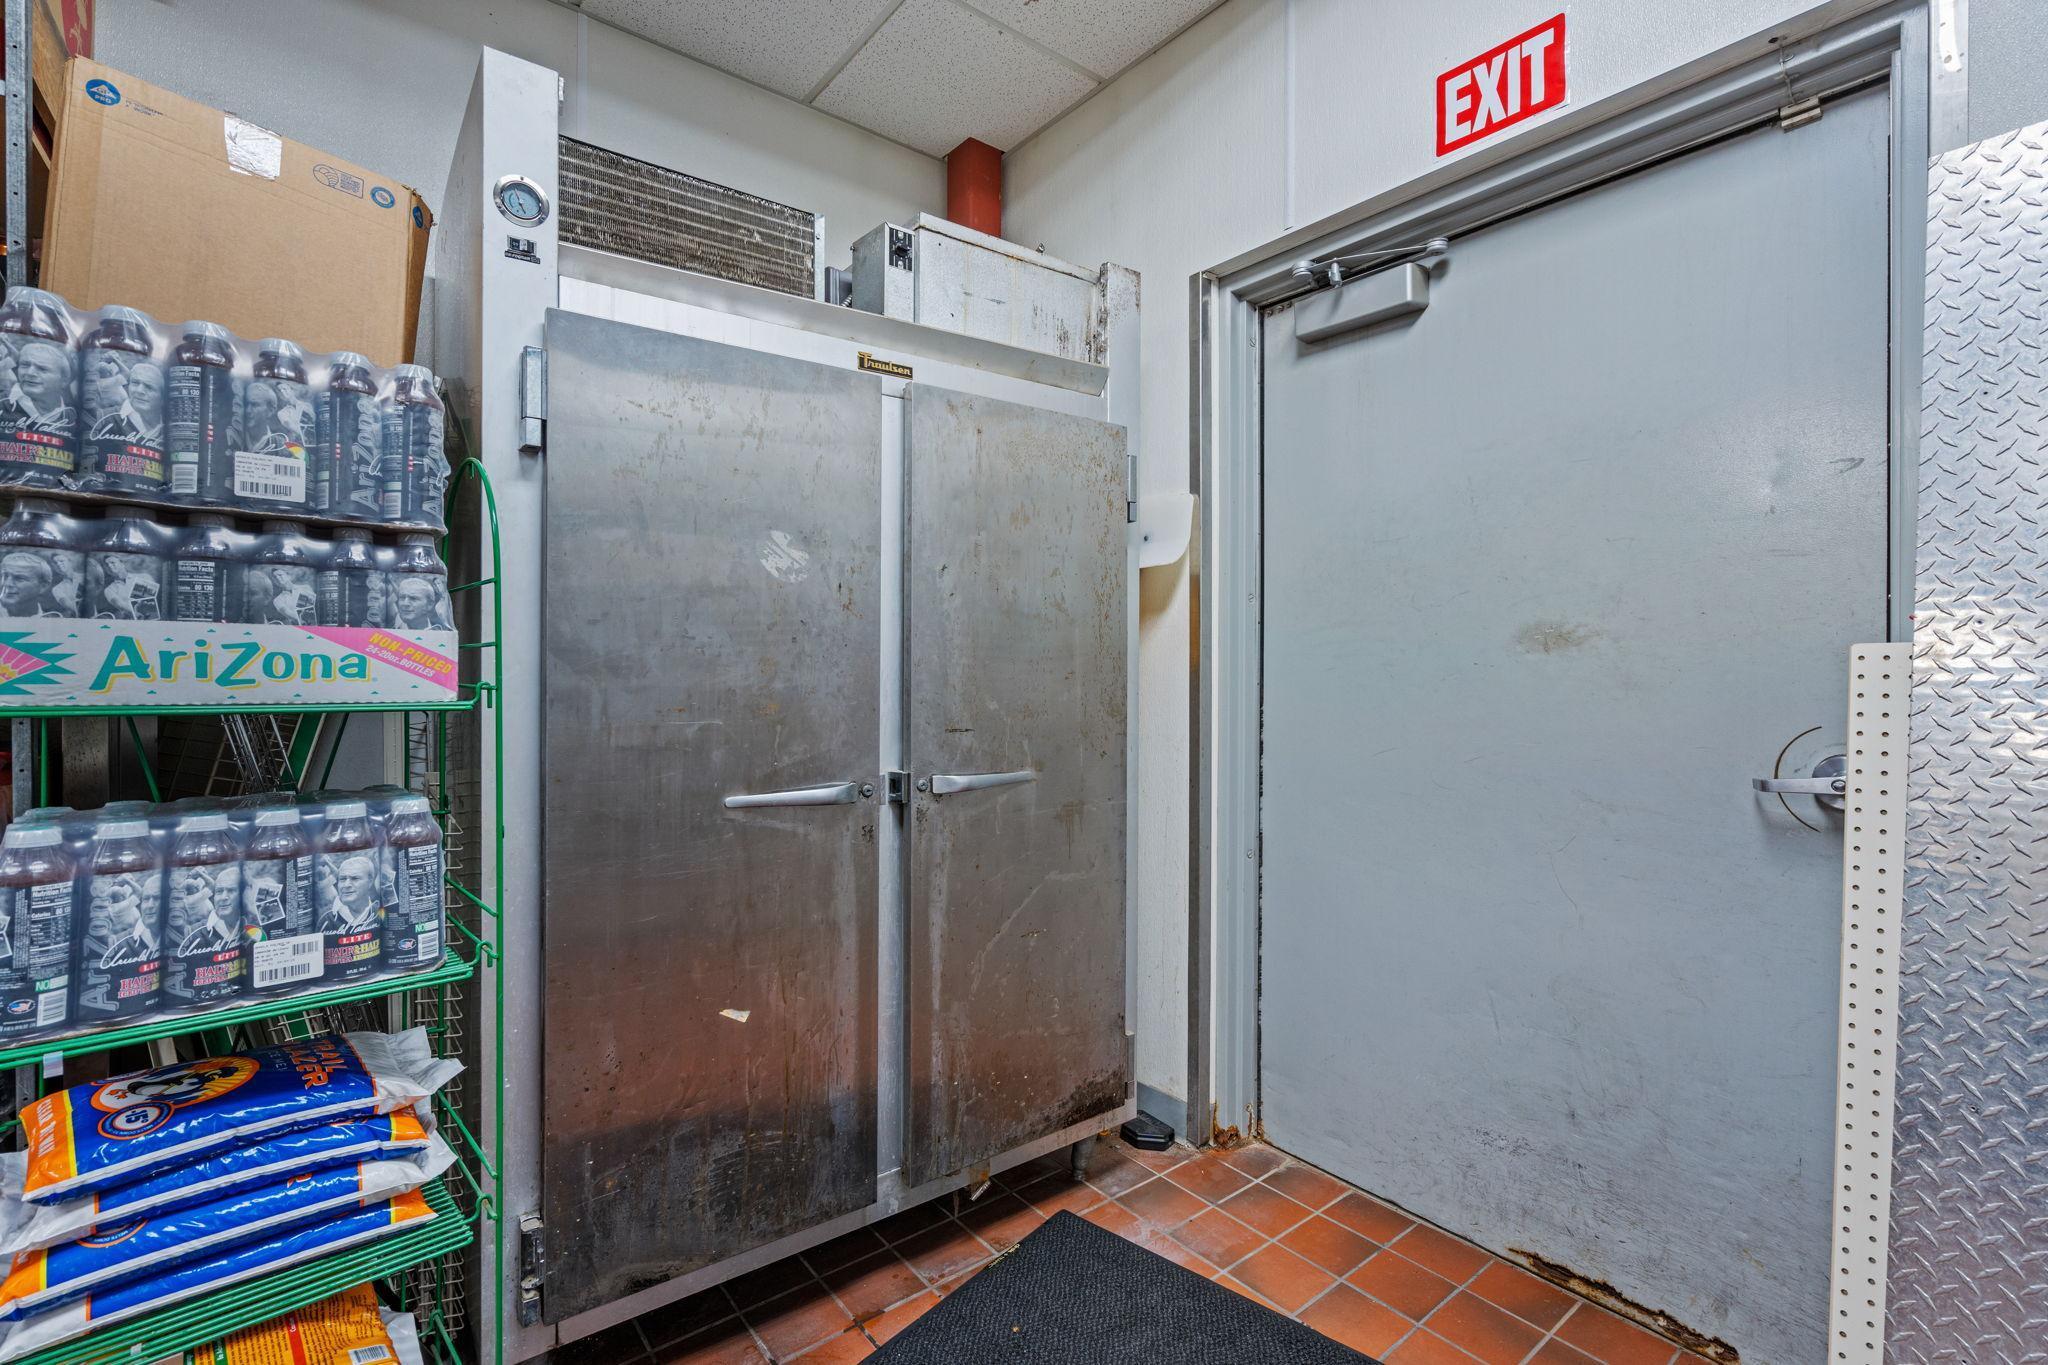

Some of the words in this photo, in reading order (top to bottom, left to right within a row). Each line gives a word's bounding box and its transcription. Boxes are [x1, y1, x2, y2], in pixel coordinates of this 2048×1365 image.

[1445, 27, 1555, 145] EXIT
[857, 351, 912, 376] Traulsen
[22, 432, 63, 446] LITE
[89, 635, 370, 693] AriZona
[369, 632, 452, 674] NON-PRICED
[343, 933, 371, 944] LITE
[35, 980, 50, 992] NO
